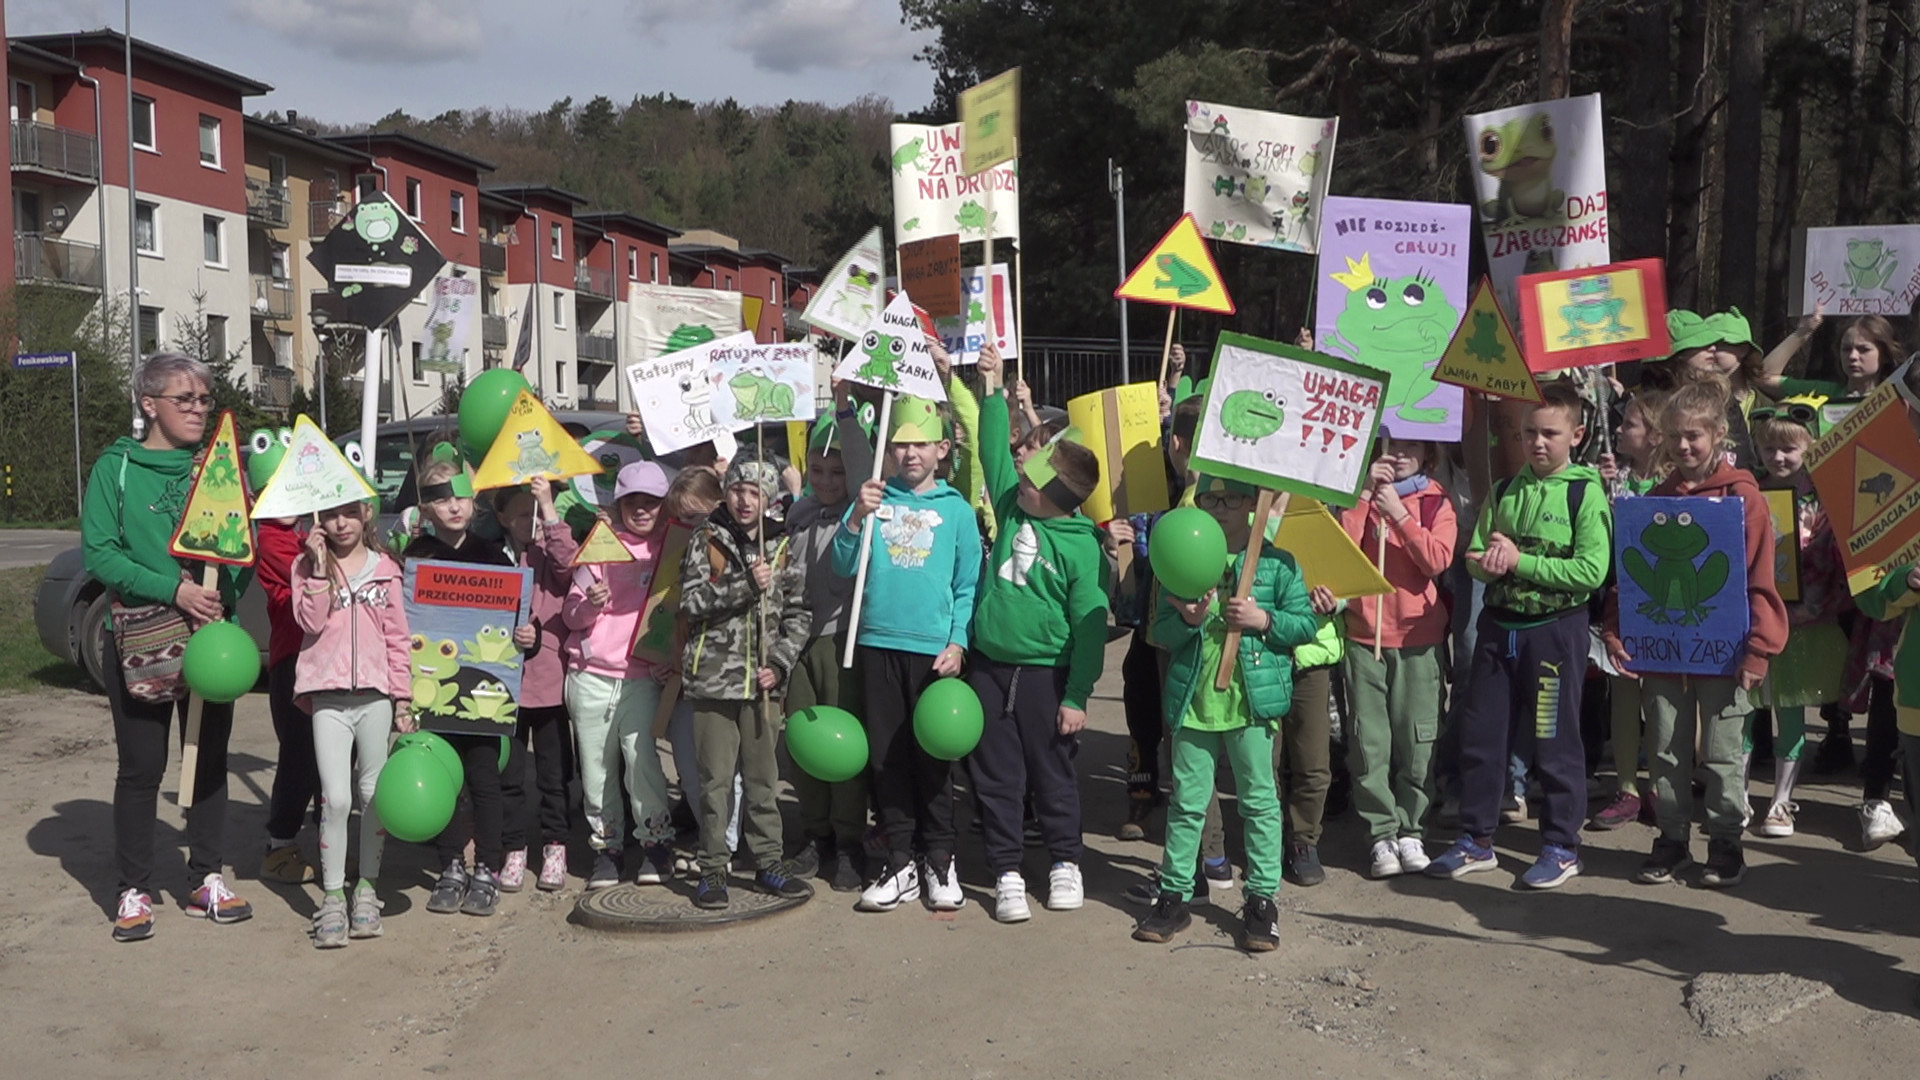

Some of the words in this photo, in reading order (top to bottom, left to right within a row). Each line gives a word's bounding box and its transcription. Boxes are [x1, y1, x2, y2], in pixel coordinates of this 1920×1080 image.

[1257, 140, 1295, 158] STOP!
[927, 153, 957, 176] ŻA
[918, 177, 949, 200] NA
[1567, 191, 1608, 220] DAJ
[1335, 218, 1366, 236] NIE
[1394, 241, 1456, 257] CAŁUJ!
[1810, 271, 1836, 306] DAJ
[883, 312, 920, 329] UWAGA
[911, 341, 929, 354] NA
[945, 333, 988, 354] ŻAB
[632, 358, 694, 384] Ratujmy
[1443, 365, 1479, 382] UWAGA
[1486, 374, 1527, 396] ŻABY!
[1303, 371, 1380, 409] UWAGA
[1302, 394, 1365, 430] ŻABY
[1805, 431, 1844, 468] ŻABIA
[1850, 503, 1908, 553] MIGRACJA
[433, 573, 503, 589] UWAGA!!!
[418, 589, 515, 605] PRZECHODZIMY
[1623, 632, 1682, 662] CHROŃ
